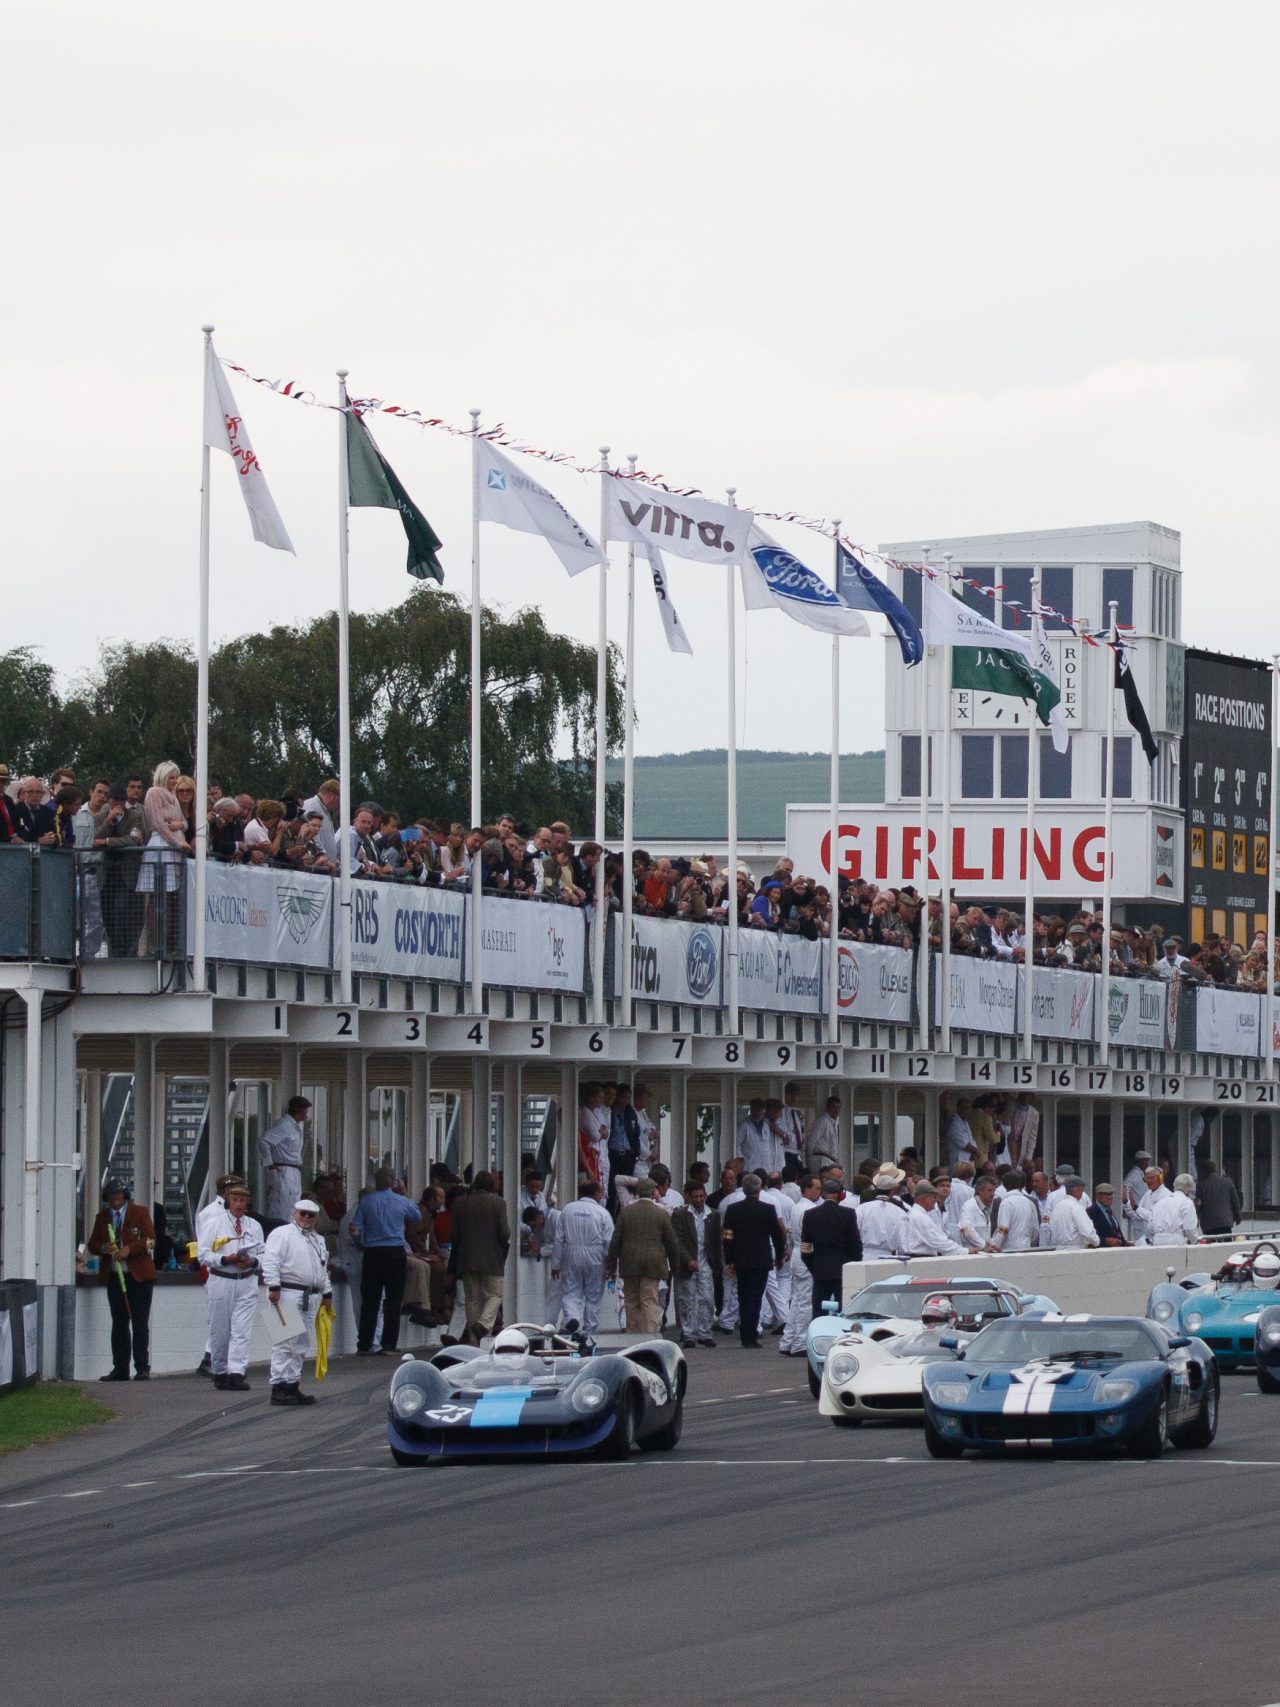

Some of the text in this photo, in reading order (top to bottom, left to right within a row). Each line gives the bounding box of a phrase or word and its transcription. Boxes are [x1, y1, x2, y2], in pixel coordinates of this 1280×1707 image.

[763, 553, 833, 598] Ford
[1065, 647, 1076, 719] ROLEX
[1195, 692, 1265, 731] RACE POSITIONS
[820, 824, 1114, 883] GIRLING
[355, 888, 379, 945] RBS
[394, 908, 460, 959] COSWORTH
[274, 1006, 281, 1029] 1
[336, 1012, 352, 1035] 2
[405, 1018, 420, 1040] 3
[467, 1022, 483, 1044] 4
[530, 1027, 544, 1048] 5
[589, 1031, 603, 1052] 6
[672, 1038, 686, 1059] 7
[725, 1042, 739, 1062] 8
[777, 1046, 790, 1065] 9
[816, 1050, 838, 1070] 10
[871, 1054, 885, 1073] 11
[908, 1057, 929, 1076] 12
[970, 1062, 991, 1080] 14
[1013, 1066, 1032, 1084] 15
[1051, 1069, 1070, 1087] 16
[1088, 1072, 1107, 1089] 17
[1125, 1075, 1145, 1092] 18
[1161, 1078, 1180, 1095] 19
[1217, 1083, 1242, 1099] 20
[1255, 1086, 1274, 1102] 21
[425, 1404, 474, 1424] 23
